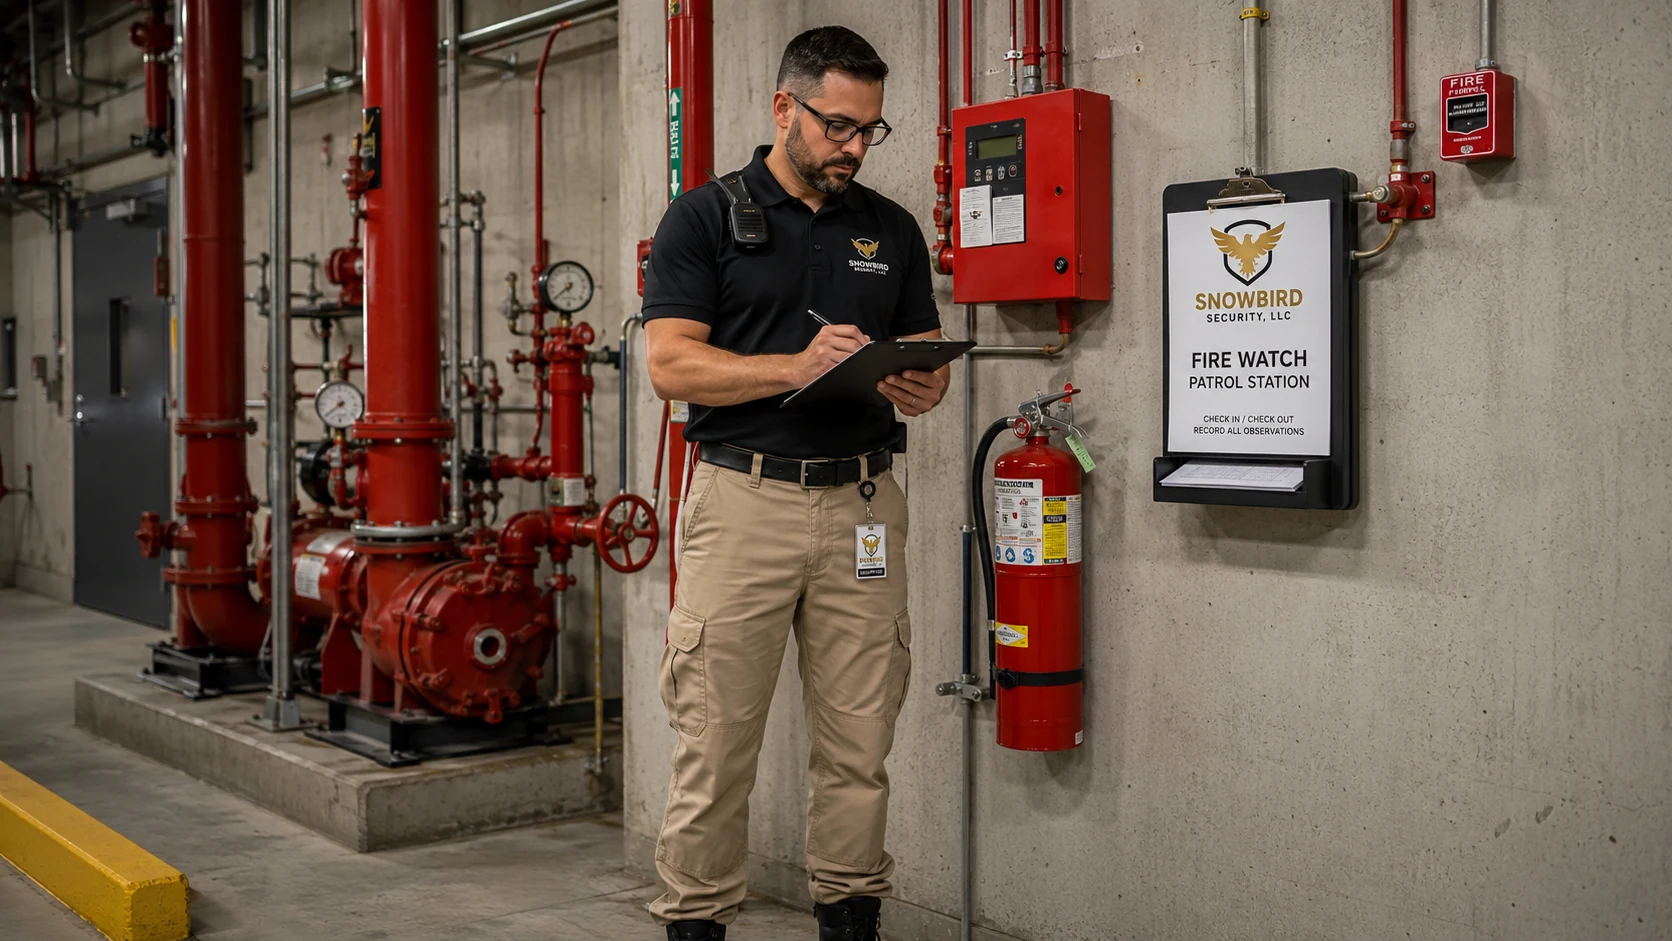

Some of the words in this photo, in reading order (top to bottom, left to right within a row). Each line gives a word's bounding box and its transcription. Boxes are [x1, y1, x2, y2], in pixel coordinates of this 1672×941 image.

[1450, 75, 1484, 88] FIRE
[1195, 288, 1303, 310] SNOWBIRD
[1206, 312, 1266, 323] SECURITY,
[1270, 310, 1291, 321] LLC
[1192, 351, 1232, 369] FIRE
[1237, 349, 1307, 368] WATCH
[1189, 375, 1243, 389] PATROL
[1247, 374, 1310, 389] STATION
[1203, 415, 1230, 423] CHECK
[1231, 415, 1241, 423] IN
[1242, 415, 1246, 424] /
[1247, 415, 1275, 424] CHECK
[1276, 415, 1295, 424] OUT
[1193, 426, 1226, 435] RECORD
[1227, 427, 1242, 435] ALL
[1243, 427, 1305, 436] OBSERVATIONS
